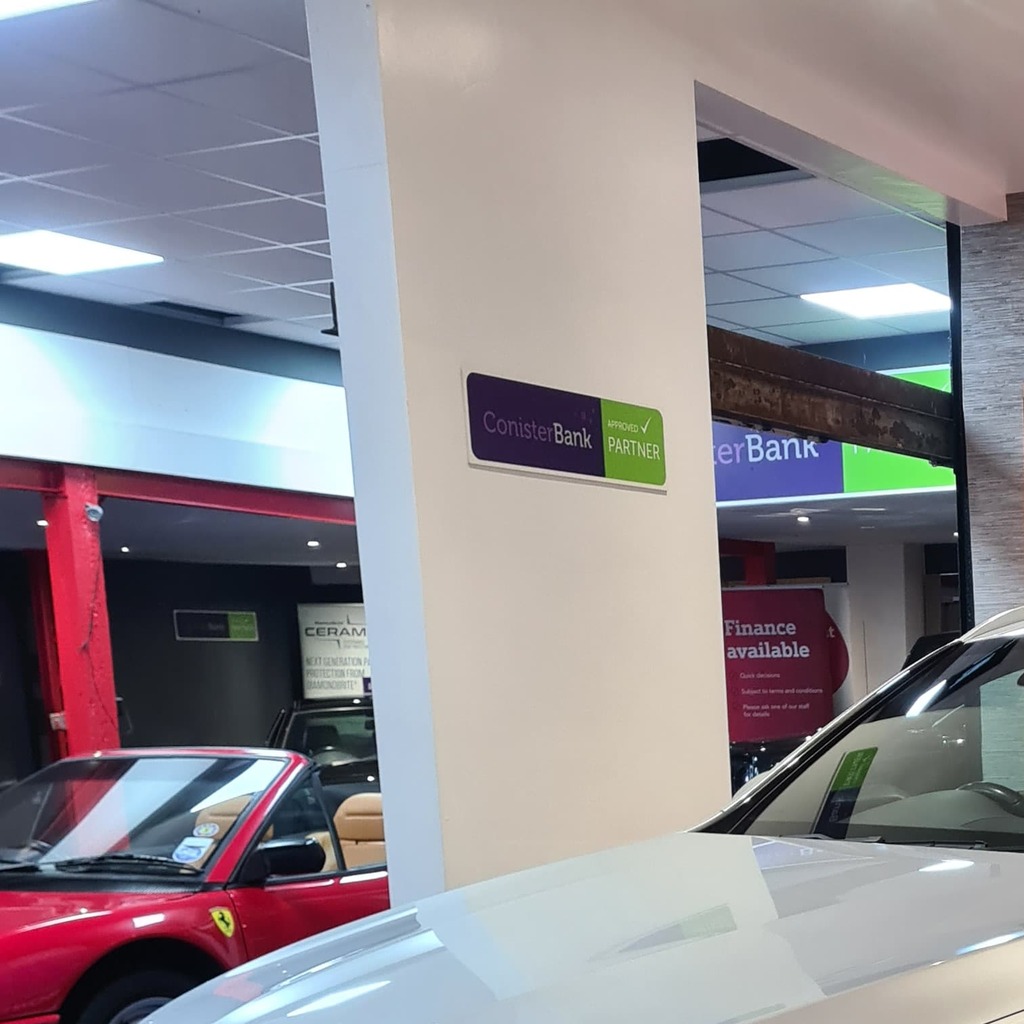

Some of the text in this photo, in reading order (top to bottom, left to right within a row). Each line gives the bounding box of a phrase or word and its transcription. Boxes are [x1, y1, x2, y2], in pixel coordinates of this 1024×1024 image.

[482, 410, 593, 449] ConisterBank
[607, 419, 639, 433] APPROVED
[608, 436, 660, 460] PARTNER
[724, 620, 796, 636] Finance
[727, 641, 810, 659] available
[305, 656, 321, 666] NEXT
[323, 656, 362, 666] GENERATION
[305, 669, 364, 678] PROTECTION FROM
